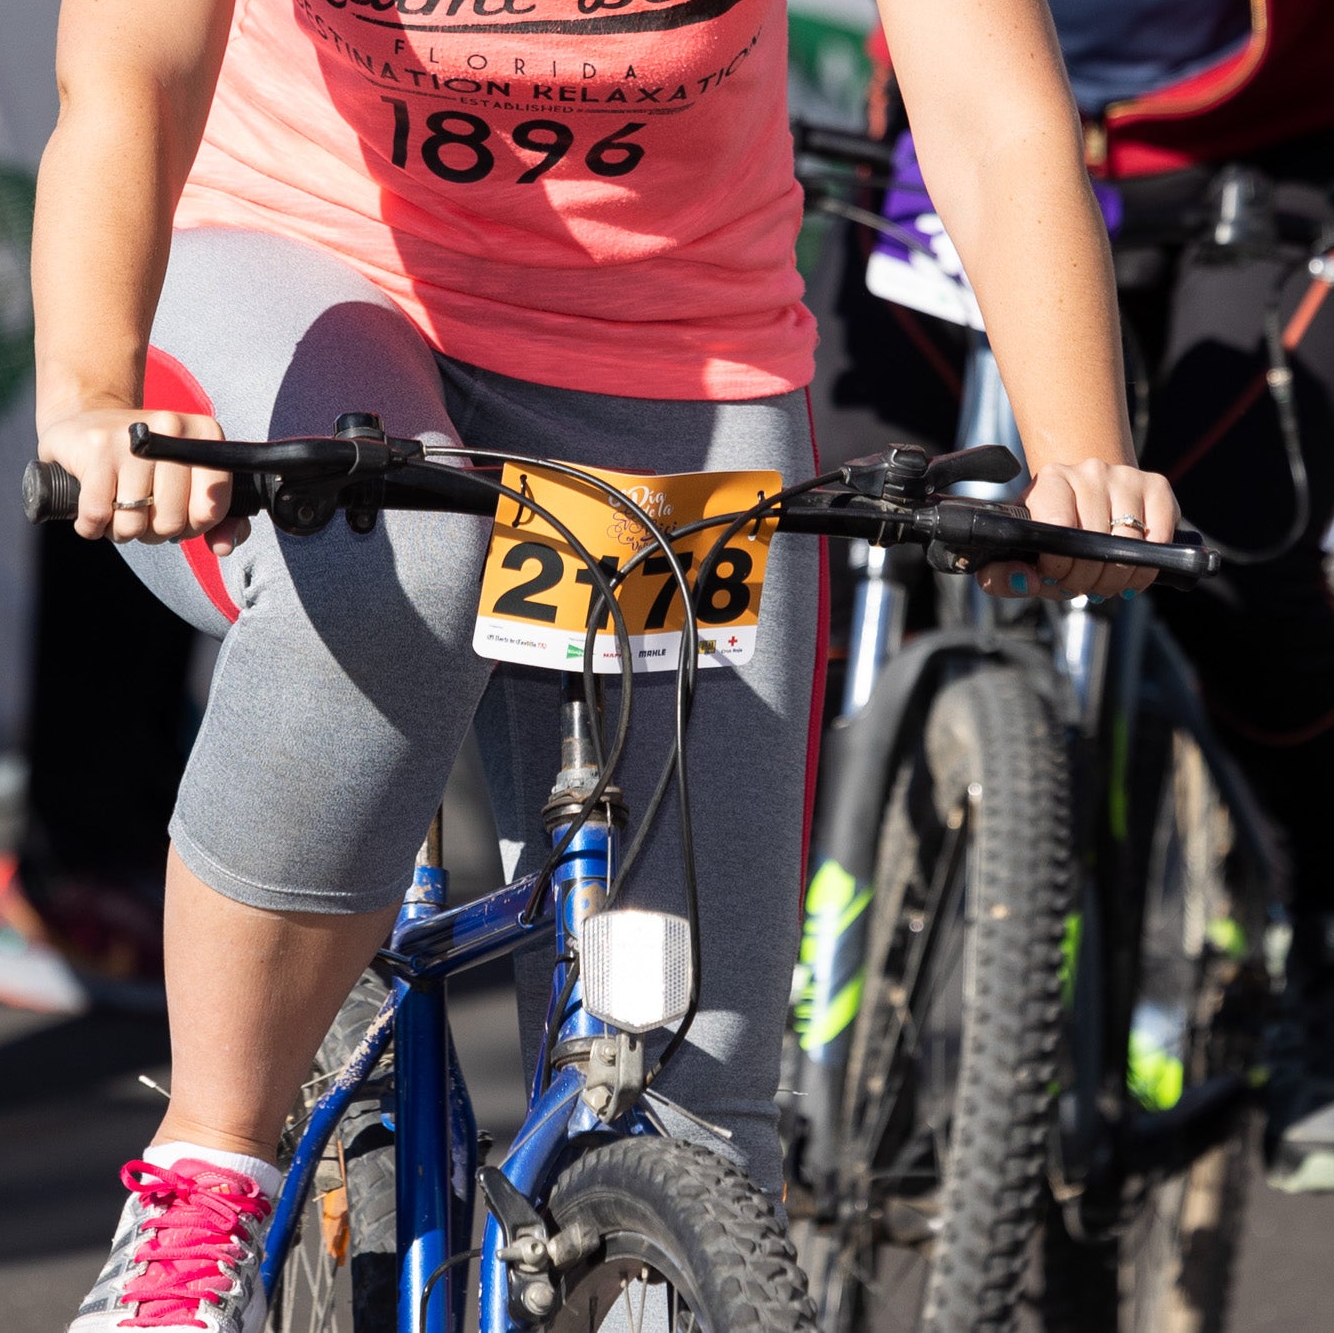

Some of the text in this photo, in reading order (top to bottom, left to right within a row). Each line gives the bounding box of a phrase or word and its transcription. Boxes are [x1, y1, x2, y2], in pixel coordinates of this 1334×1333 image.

[394, 38, 637, 79] FLORIDA
[460, 96, 574, 114] ESTABLISHED
[380, 95, 647, 184] 1896
[492, 541, 754, 631] 2178
[638, 648, 667, 659] MAHLE
